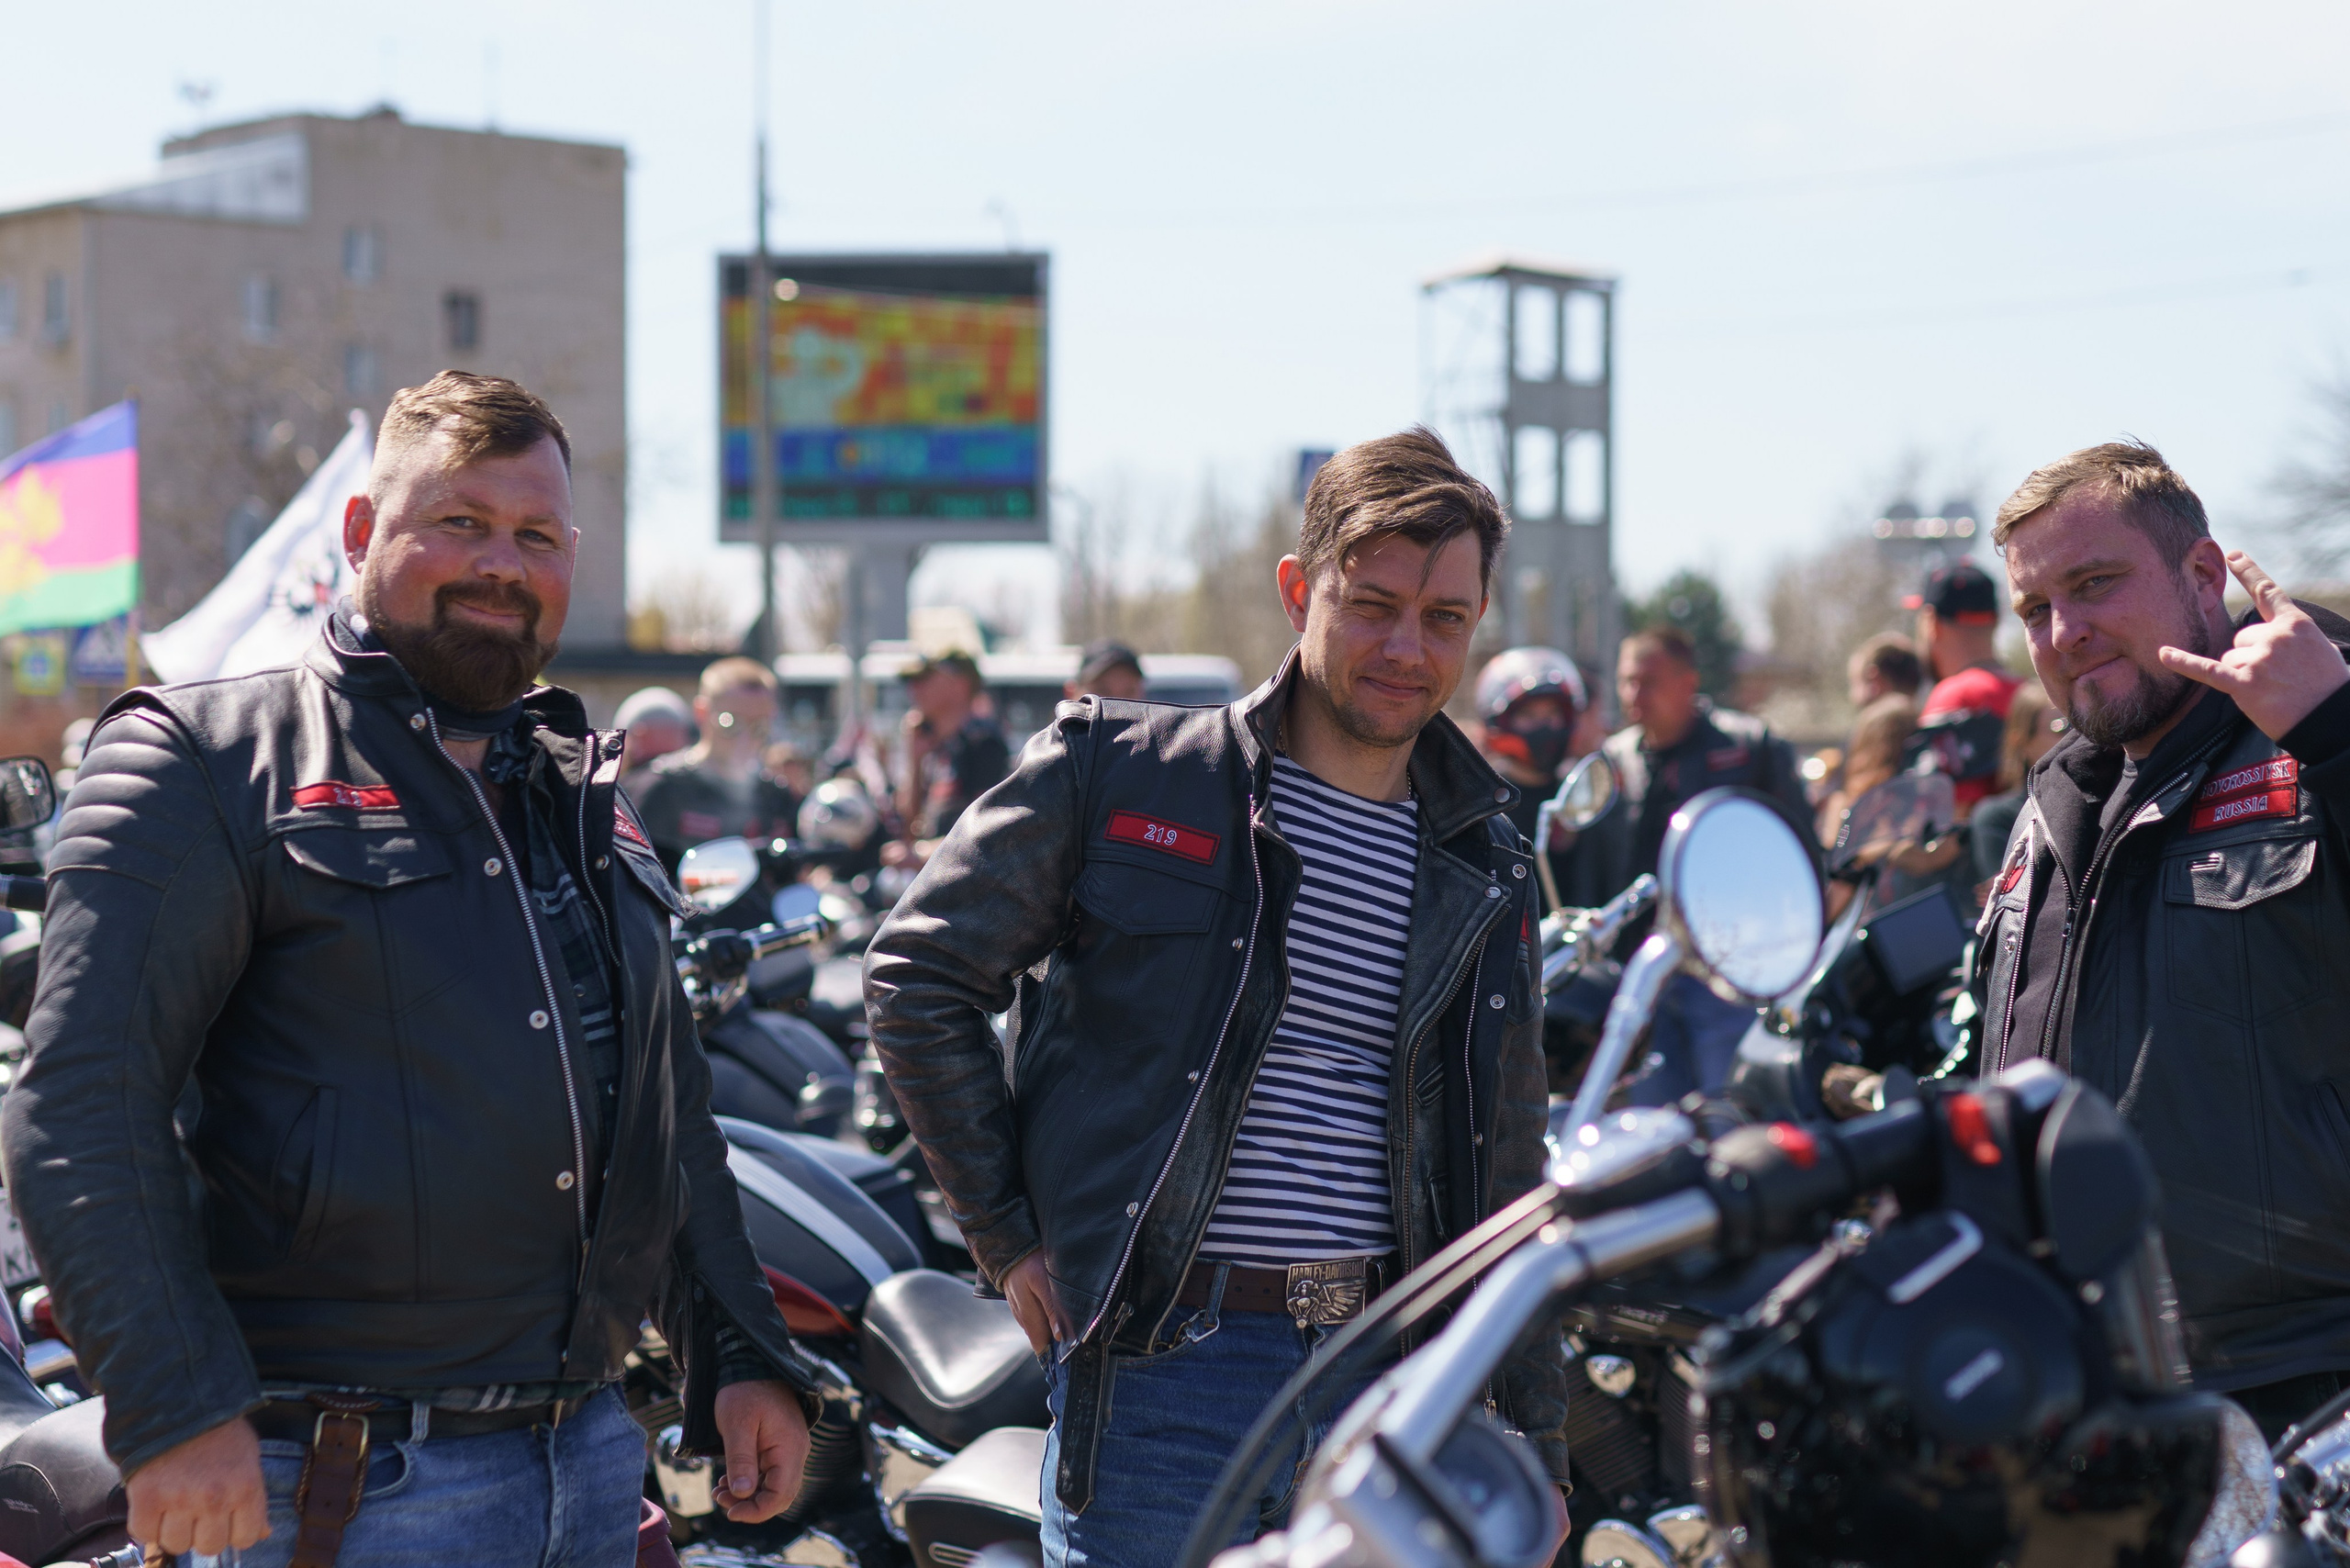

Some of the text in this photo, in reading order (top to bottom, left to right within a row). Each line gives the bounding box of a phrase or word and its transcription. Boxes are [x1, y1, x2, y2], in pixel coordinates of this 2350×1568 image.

[2201, 760, 2292, 800] NOVOROSSIYSK
[2212, 795, 2268, 823] RUSSIA
[1144, 823, 1178, 846] 219
[1291, 1261, 1363, 1282] HARLEY-DAVIDSON
